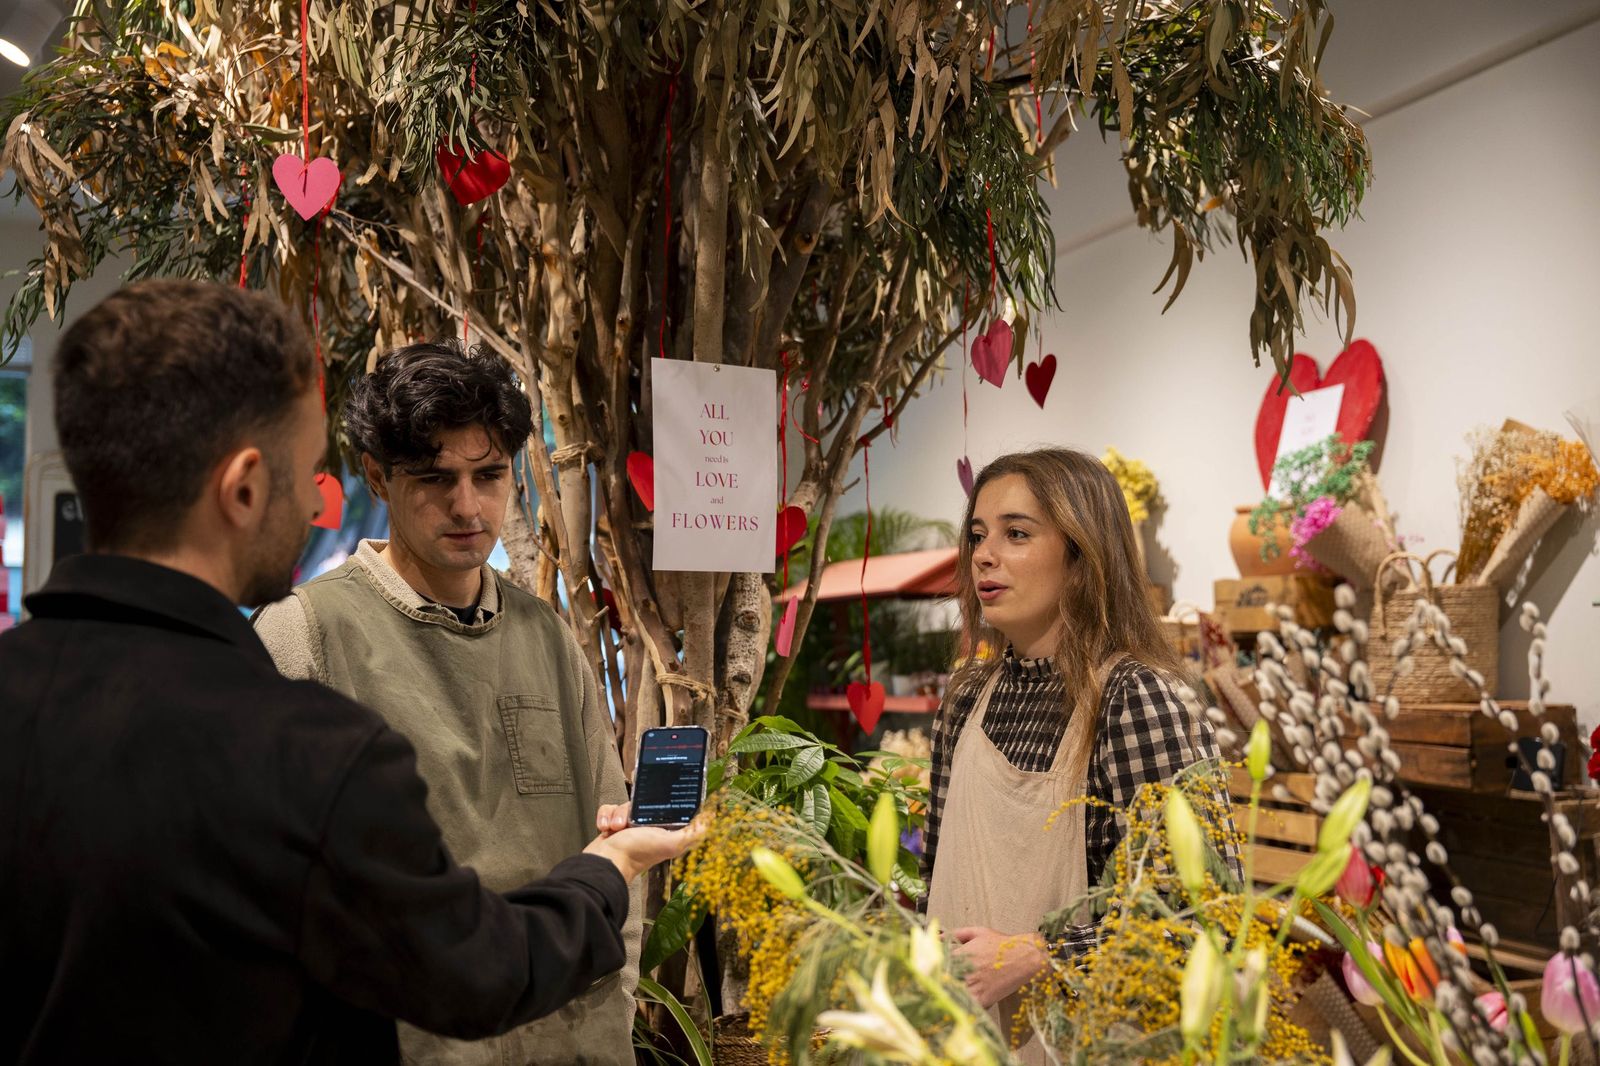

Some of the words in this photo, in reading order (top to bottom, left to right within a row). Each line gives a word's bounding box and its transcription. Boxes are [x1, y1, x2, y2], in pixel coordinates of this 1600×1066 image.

[700, 403, 730, 420] ALL
[699, 429, 734, 447] YOU
[705, 455, 722, 463] need
[723, 455, 729, 463] is
[696, 471, 739, 489] LOVE
[710, 495, 724, 505] and
[672, 512, 759, 532] FLOWERS
